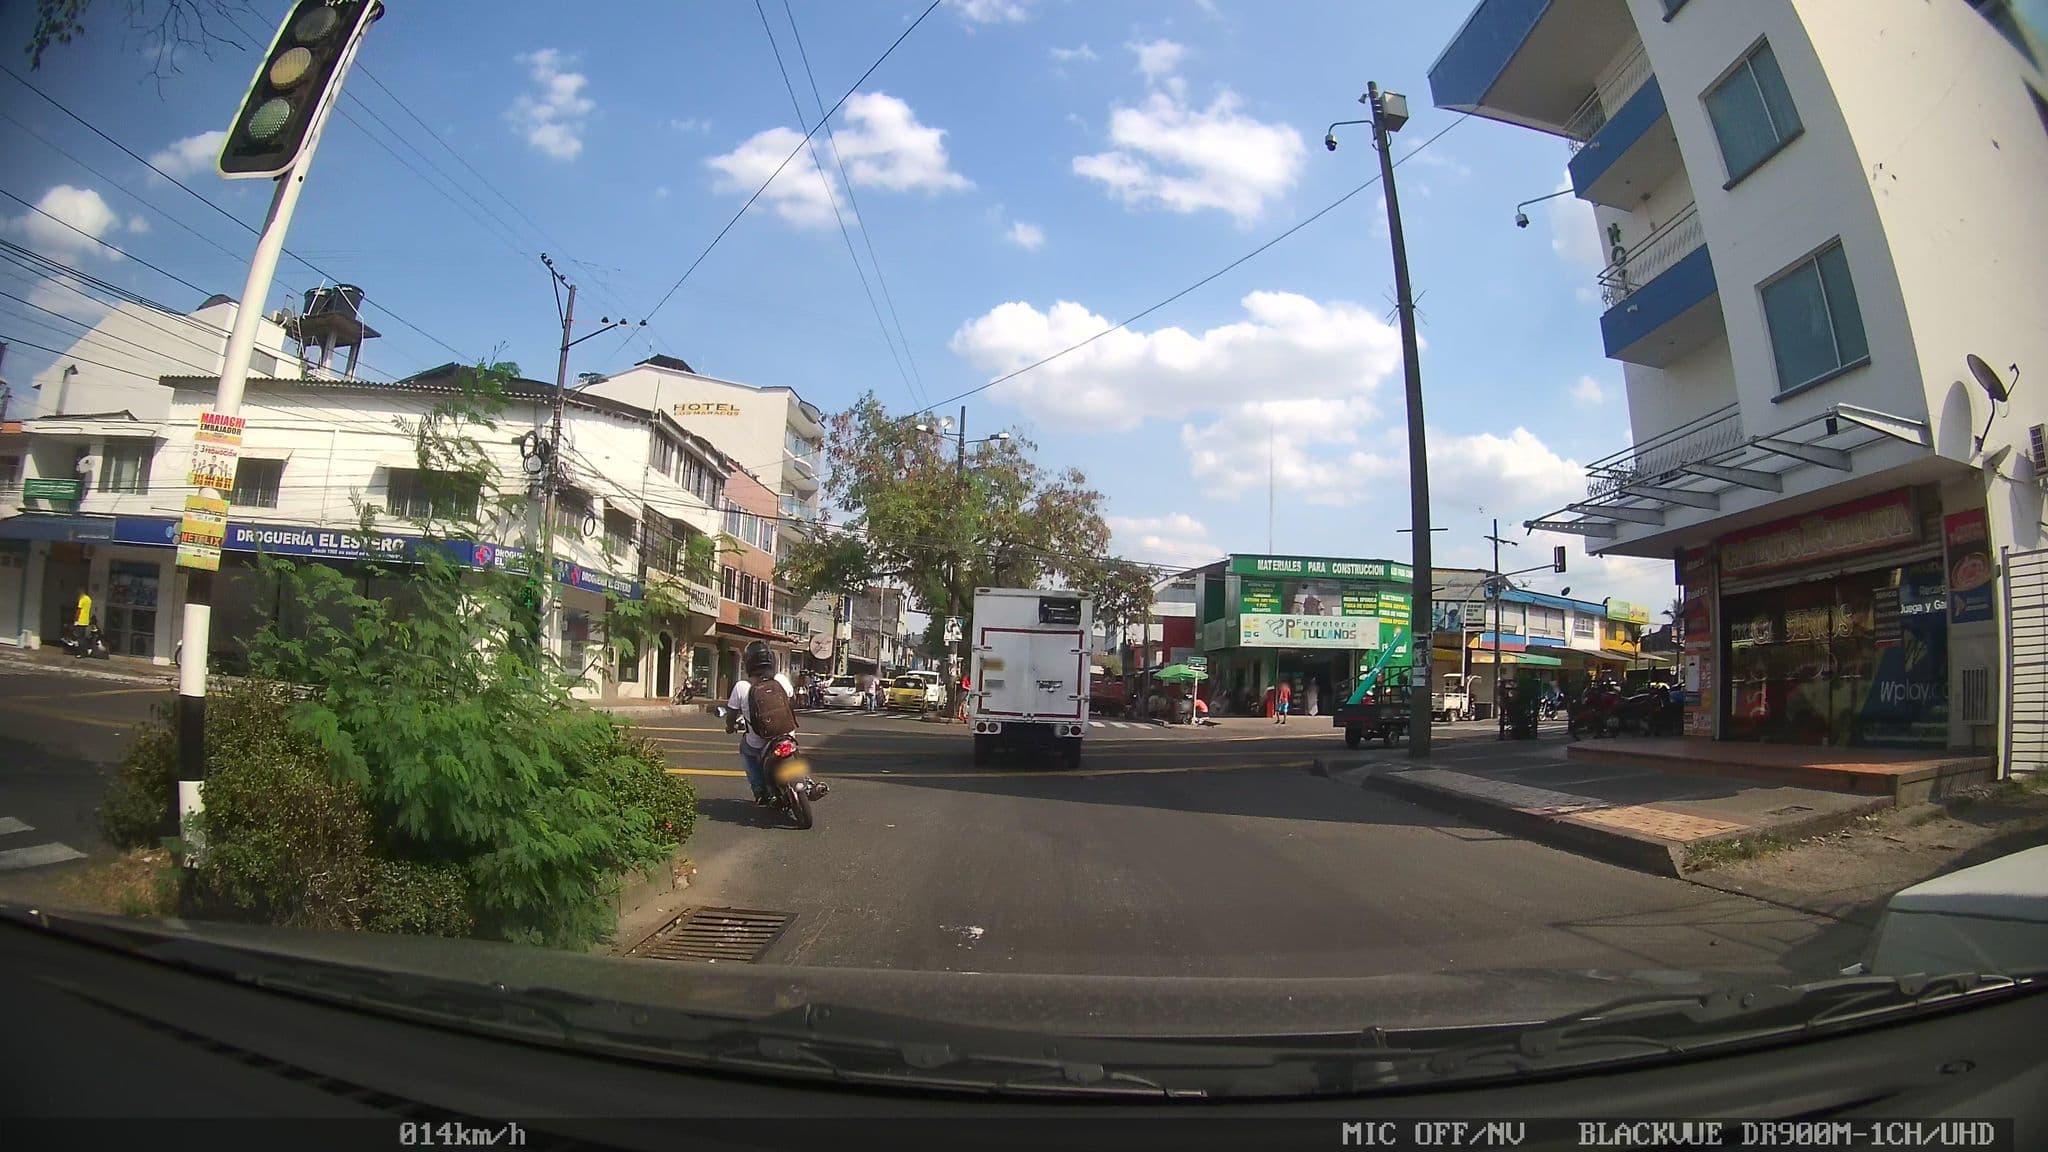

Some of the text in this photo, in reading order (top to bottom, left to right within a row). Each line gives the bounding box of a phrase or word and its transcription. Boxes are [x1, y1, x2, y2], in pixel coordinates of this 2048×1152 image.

[673, 403, 740, 411] HOTEL
[201, 413, 246, 428] MARIACHI
[200, 424, 242, 435] EMBAJADOR
[181, 532, 221, 546] NETFLIX
[237, 529, 314, 546] DROGUERÍA
[319, 534, 338, 548] EL
[1257, 559, 1302, 572] MATERIALES
[1307, 561, 1326, 573] PARA
[1900, 602, 1923, 615] Juega
[1925, 602, 1932, 613] y
[1285, 618, 1357, 640] PITULLANOS
